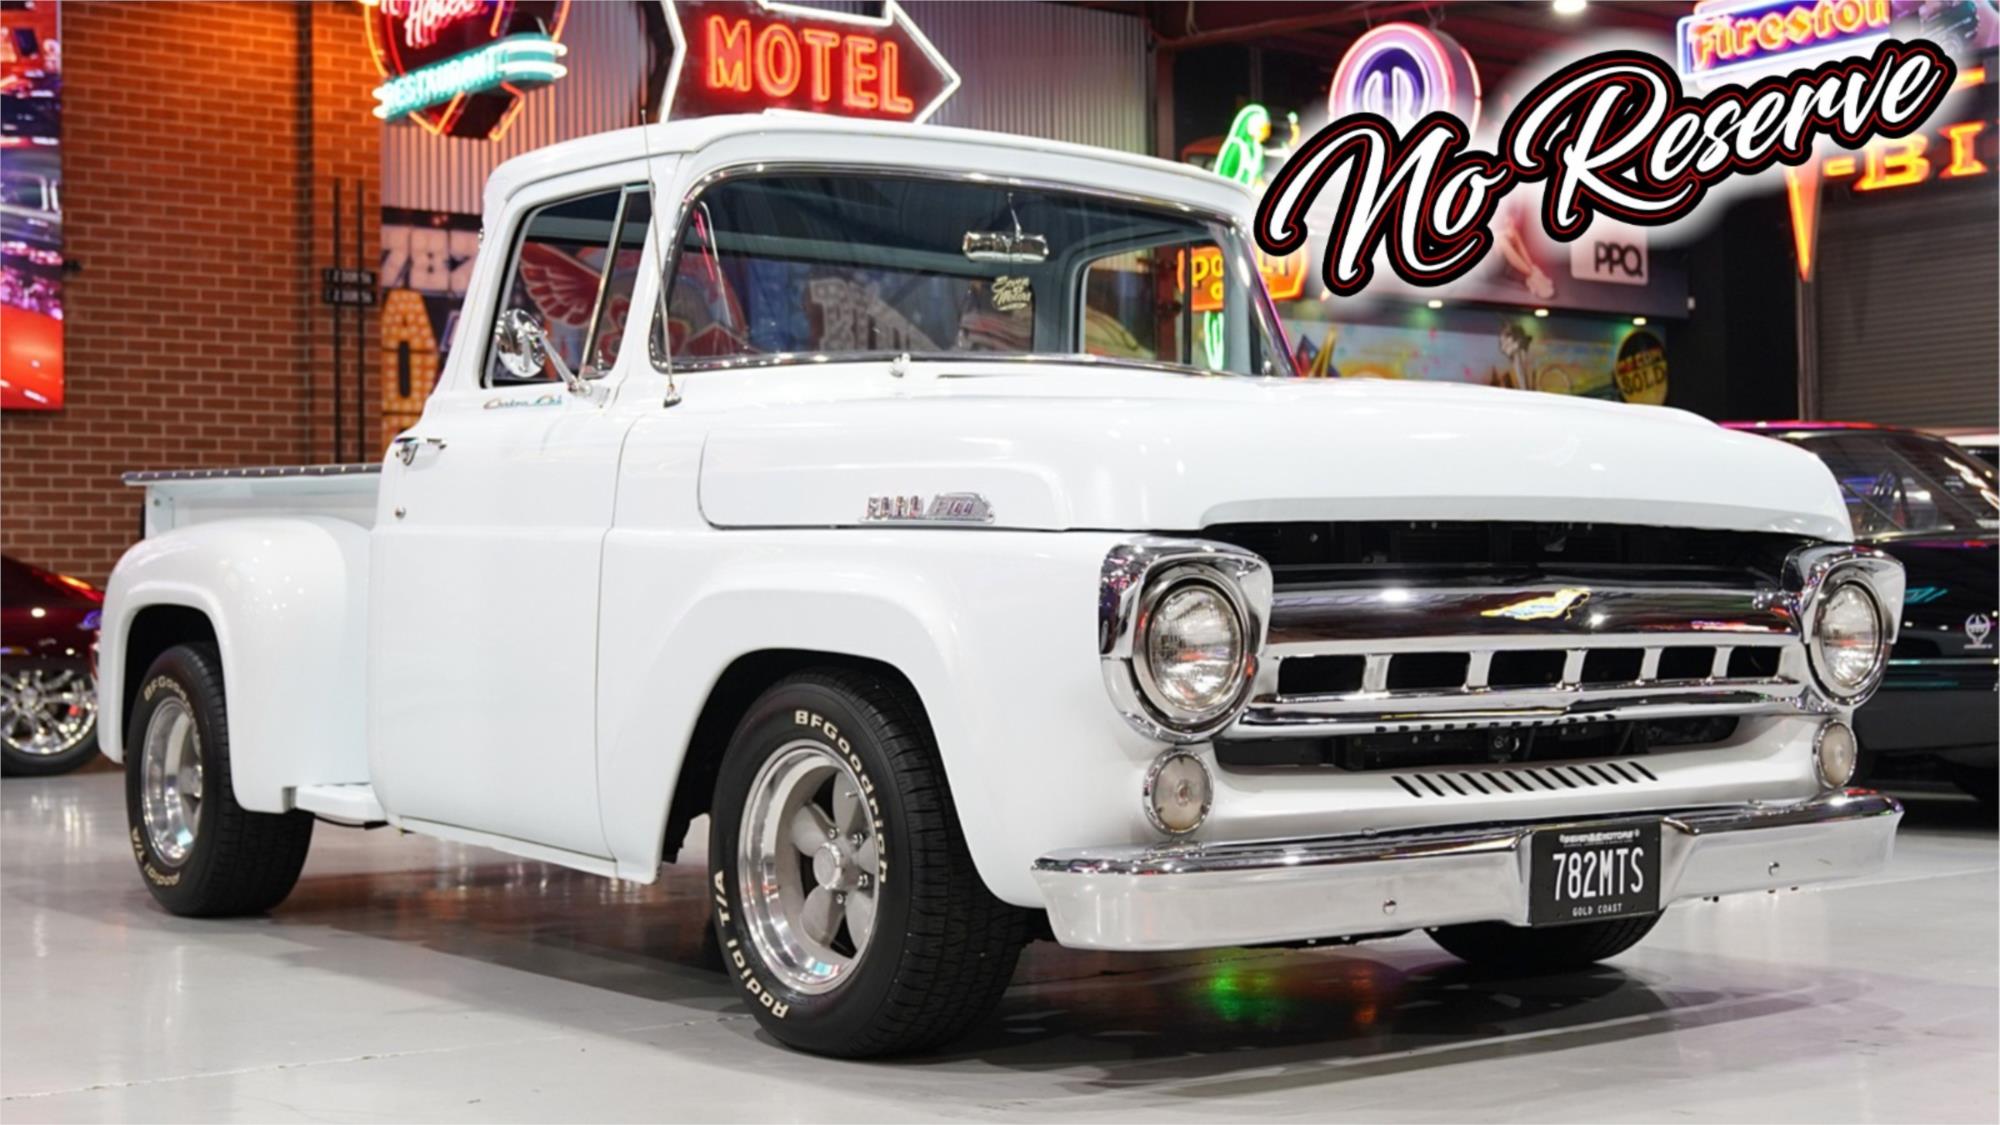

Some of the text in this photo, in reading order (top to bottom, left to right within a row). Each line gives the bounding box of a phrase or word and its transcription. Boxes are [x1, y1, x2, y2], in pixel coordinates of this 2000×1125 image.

[706, 15, 914, 113] MOTEL
[1594, 240, 1643, 277] PPQ
[795, 709, 888, 883] BFGoodrich
[1552, 847, 1645, 901] 782MTS
[1572, 902, 1623, 917] GOLD COAST
[713, 869, 790, 1020] Radial T/A
